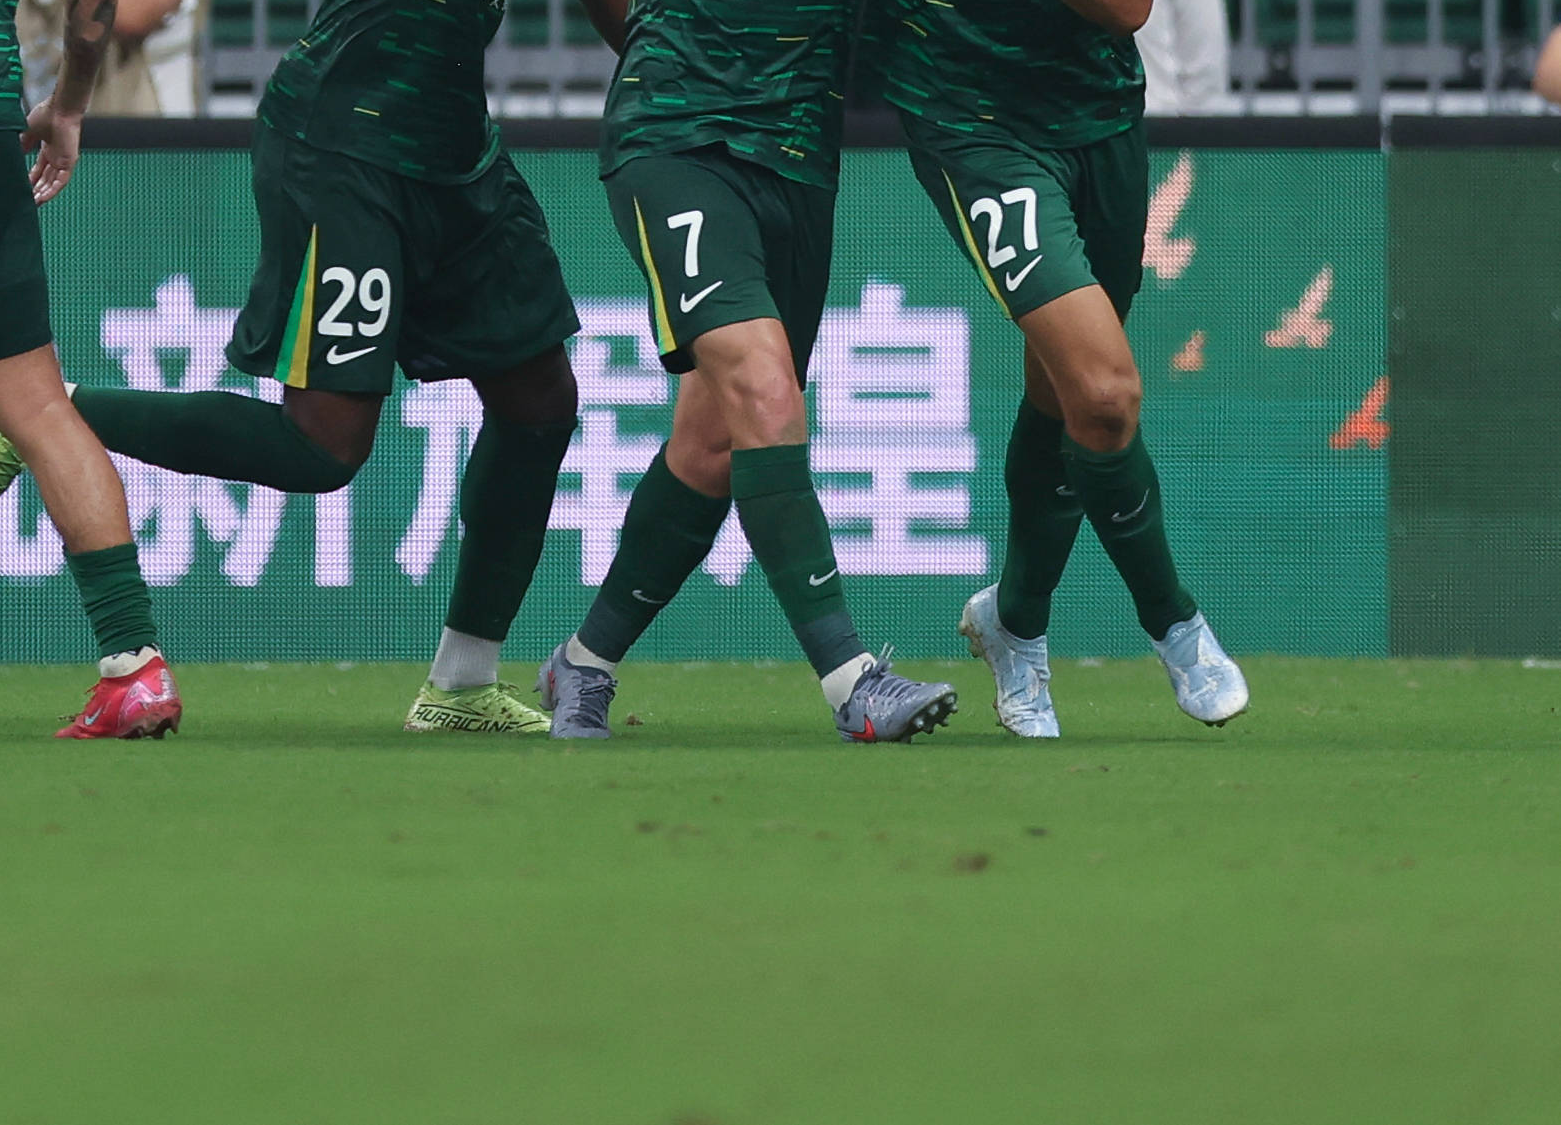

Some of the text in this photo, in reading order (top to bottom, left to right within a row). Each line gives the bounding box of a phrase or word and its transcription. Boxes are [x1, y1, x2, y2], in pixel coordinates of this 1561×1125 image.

[667, 209, 704, 278] 7
[970, 187, 1039, 269] 27
[317, 266, 391, 338] 29
